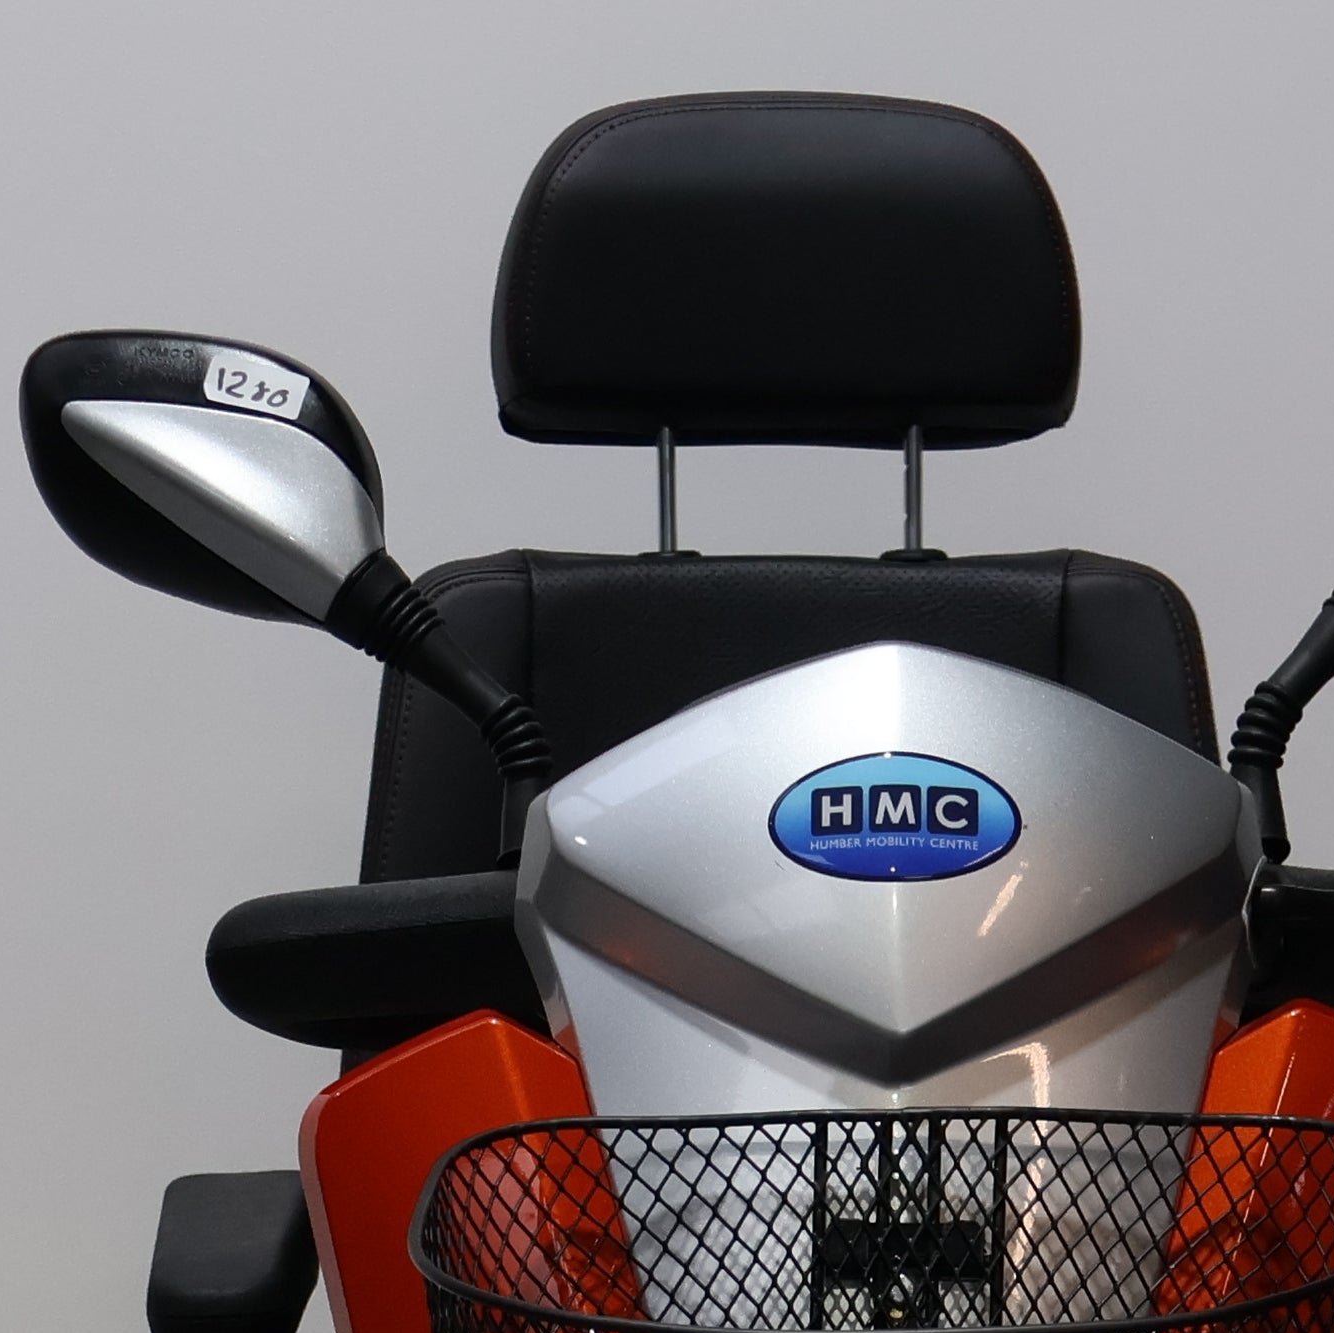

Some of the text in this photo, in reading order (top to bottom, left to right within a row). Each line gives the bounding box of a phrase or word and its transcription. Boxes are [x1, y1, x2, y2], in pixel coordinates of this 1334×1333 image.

[217, 368, 289, 407] 1280
[821, 791, 969, 829] HMC
[810, 837, 979, 851] HUMBER MOBILITY CENTRE
